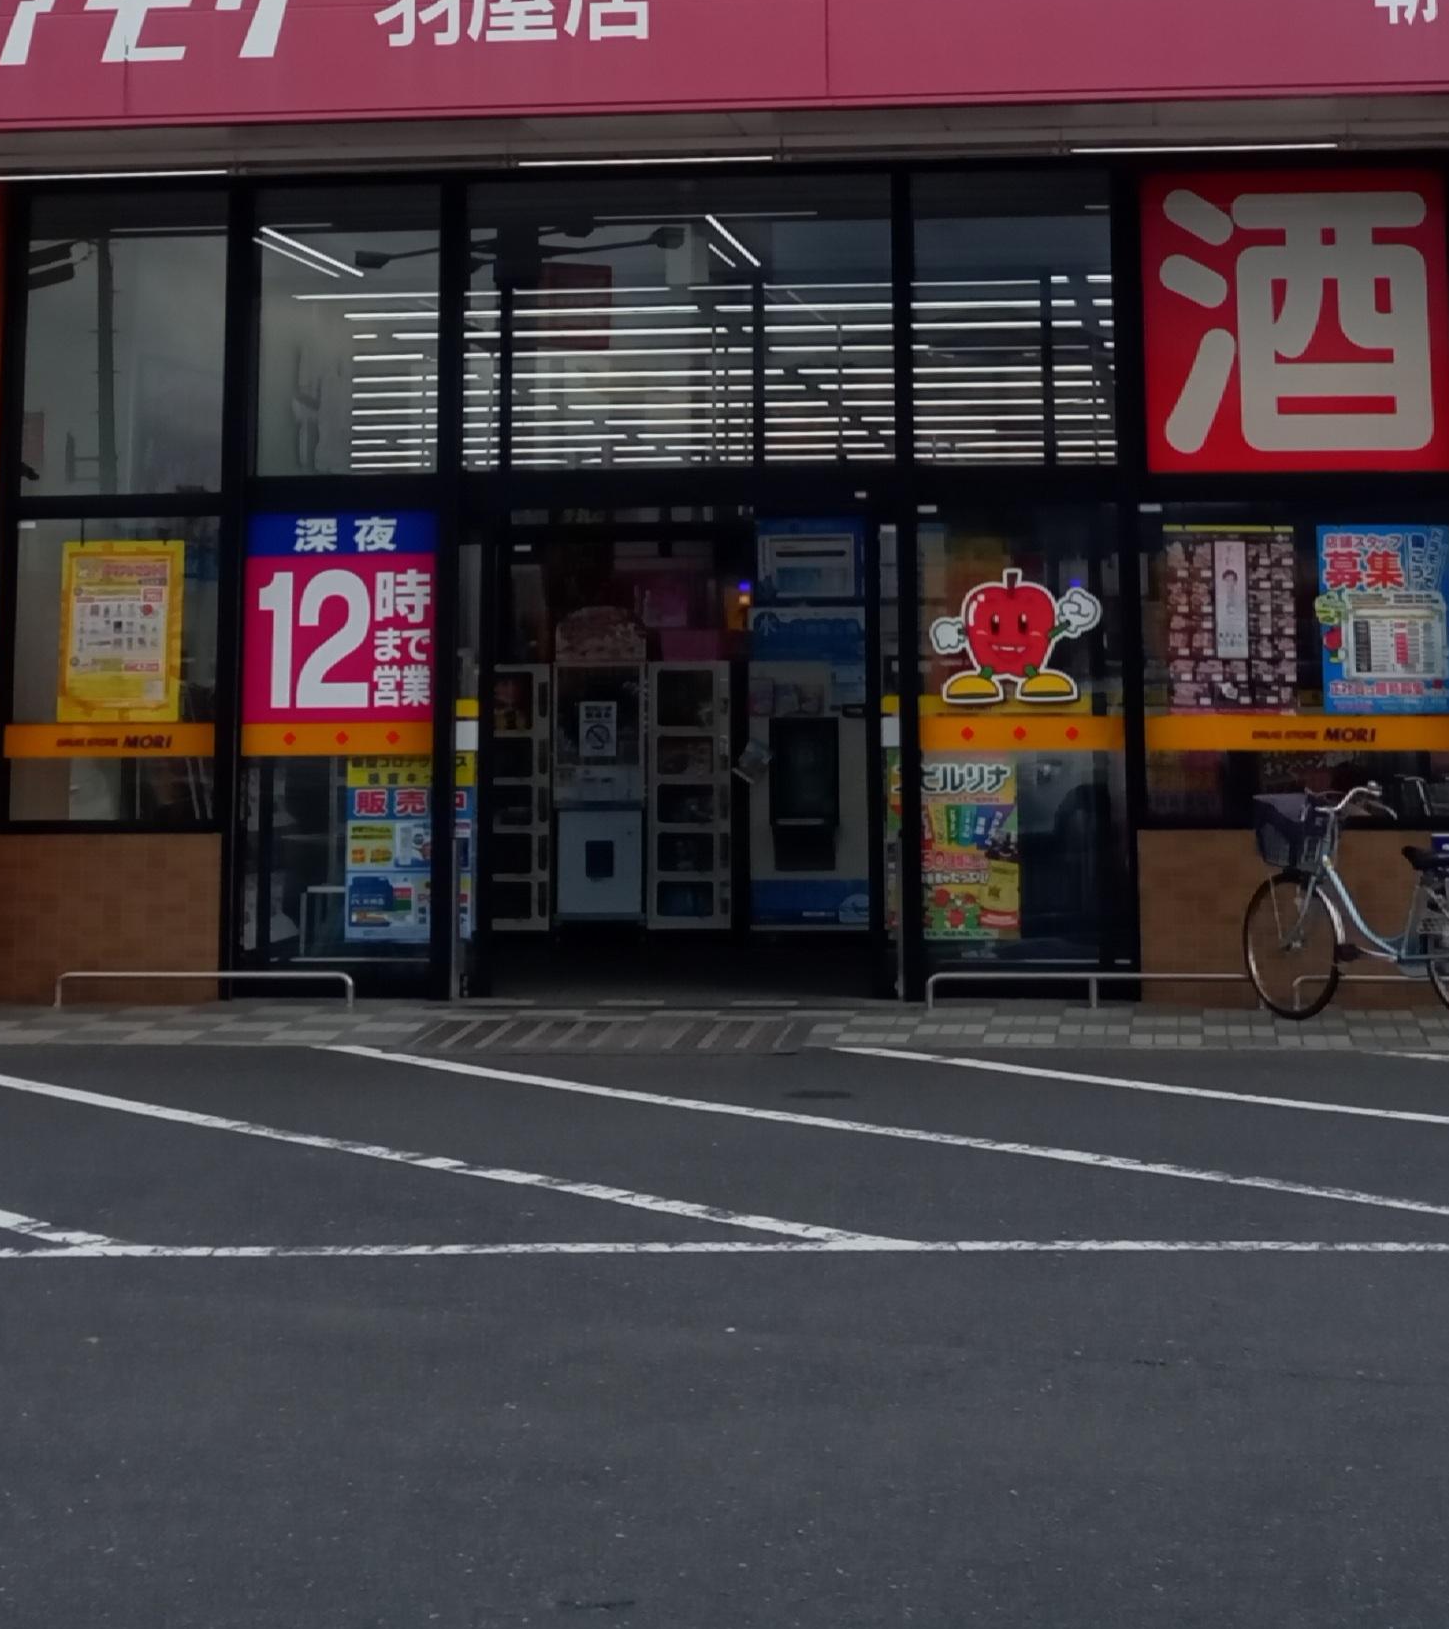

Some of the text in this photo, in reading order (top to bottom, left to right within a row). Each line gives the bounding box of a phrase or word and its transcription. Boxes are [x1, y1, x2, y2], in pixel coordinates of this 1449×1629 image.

[1159, 188, 1435, 454] 酒
[294, 517, 397, 552] 深夜
[1323, 549, 1405, 589] 募集
[258, 568, 432, 709] 12 時
[373, 628, 431, 660] まで
[372, 665, 431, 707] 営業
[122, 734, 172, 749] MORI
[1323, 727, 1376, 742] MORI
